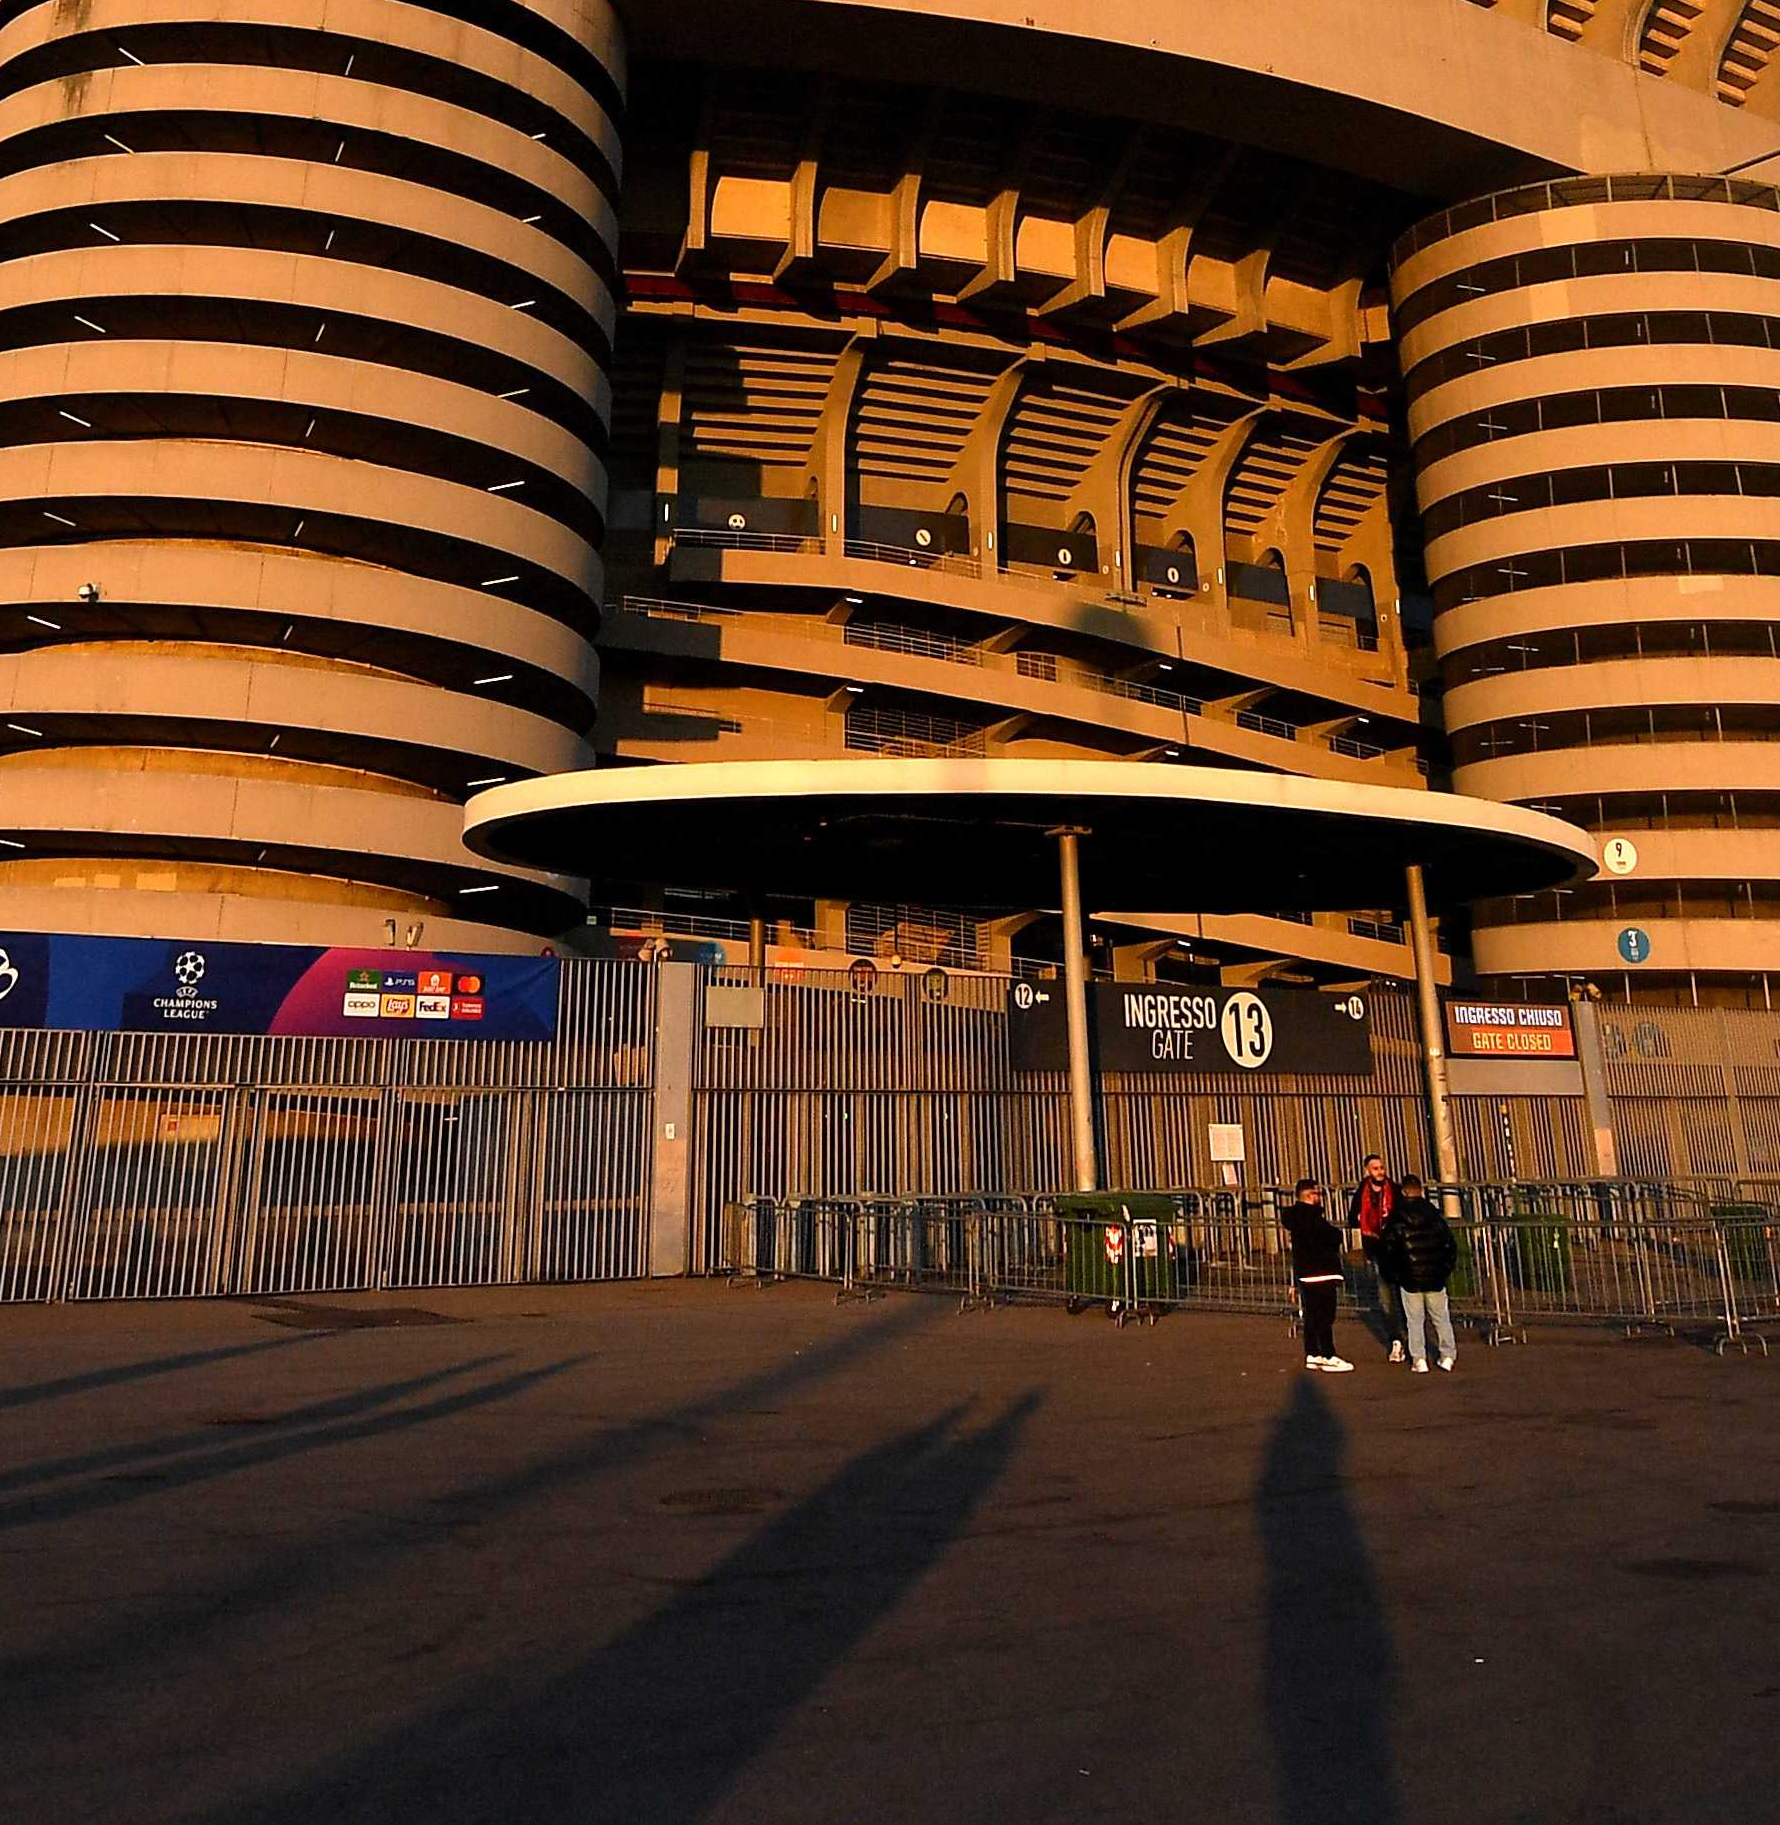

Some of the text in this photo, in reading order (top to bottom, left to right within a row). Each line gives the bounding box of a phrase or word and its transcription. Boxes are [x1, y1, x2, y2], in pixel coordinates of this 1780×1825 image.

[1615, 841, 1623, 858] 9
[153, 998, 217, 1009] CHAMPIONS
[348, 1000, 376, 1009] oppo
[1018, 986, 1031, 1006] 12
[163, 1009, 205, 1019] LEAGUE
[419, 1001, 446, 1012] FedEx
[1349, 999, 1361, 1016] 14
[1454, 1006, 1563, 1027] INGRESSO CHIUSO
[1124, 993, 1266, 1059] INGRESSO 13
[1151, 1029, 1194, 1060] GATE
[1472, 1032, 1552, 1051] GATE CLOSED
